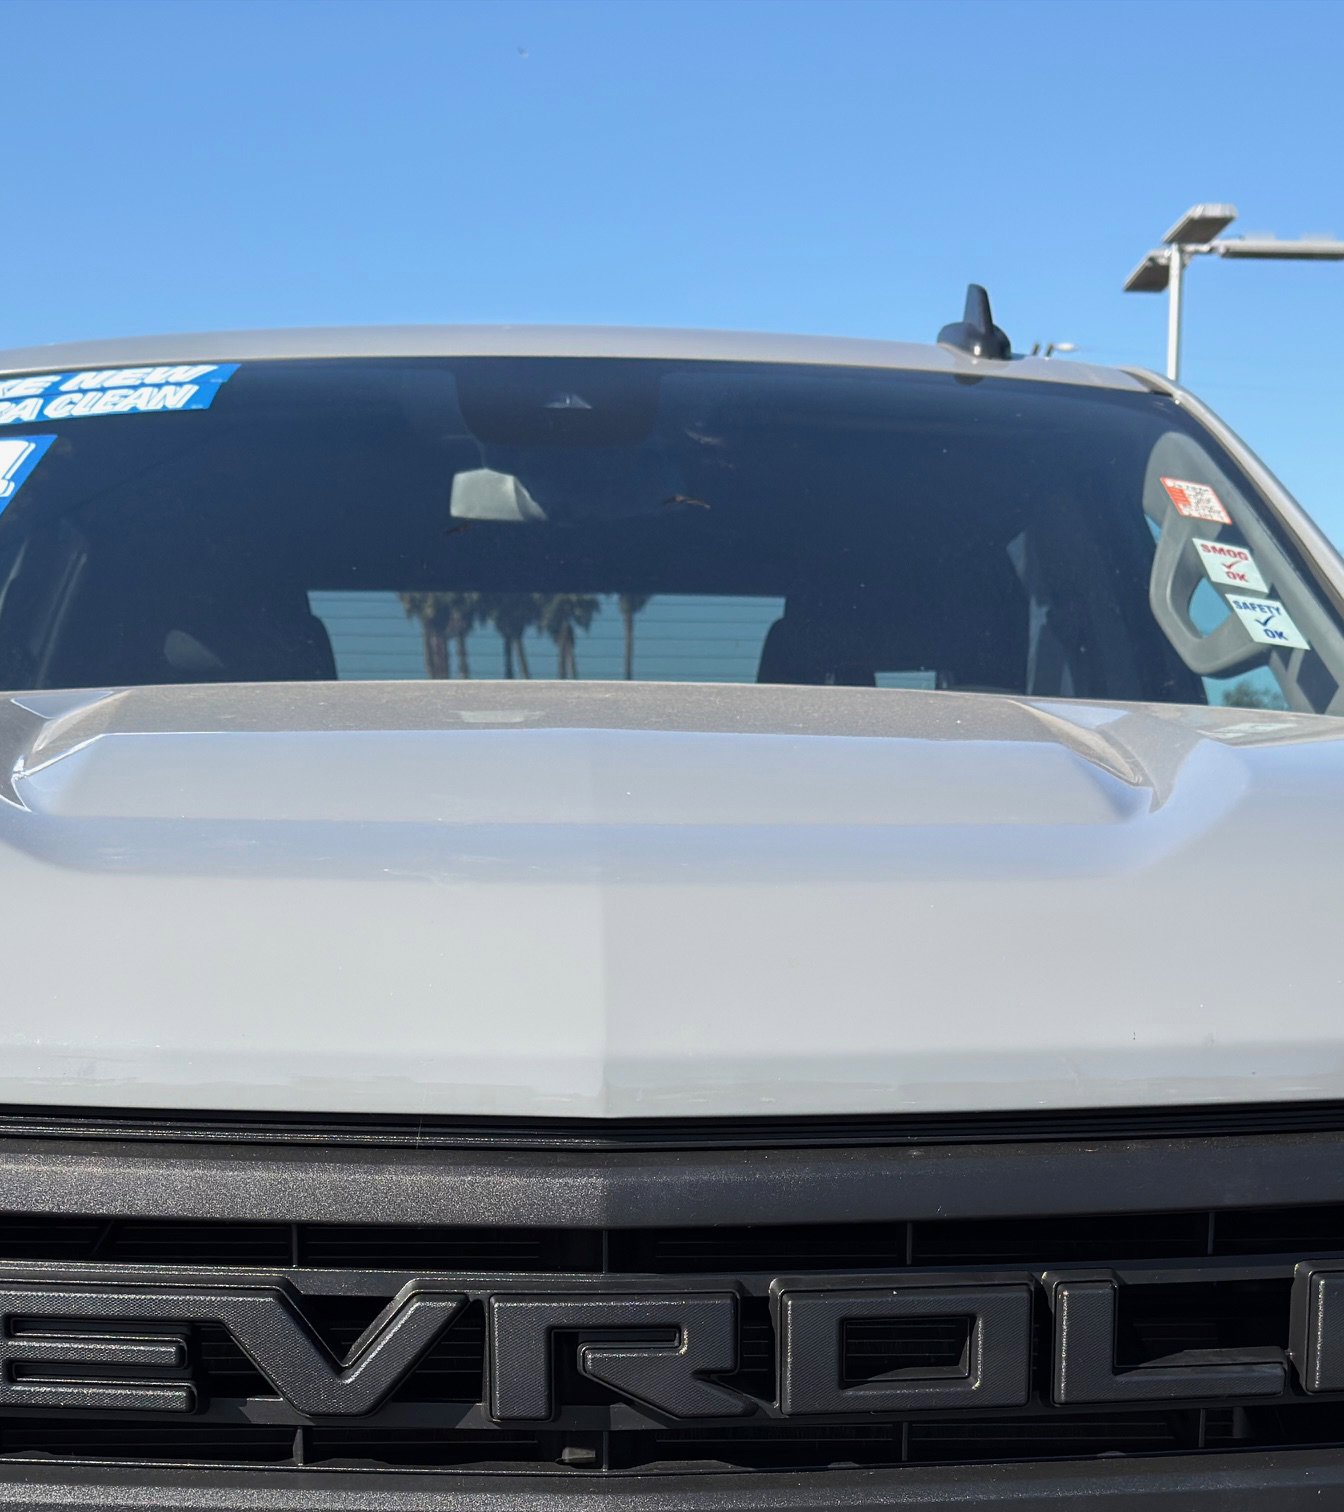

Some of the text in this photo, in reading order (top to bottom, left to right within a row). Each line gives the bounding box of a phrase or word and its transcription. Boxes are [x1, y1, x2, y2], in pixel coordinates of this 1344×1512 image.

[59, 364, 219, 392] NEW
[43, 384, 201, 418] CLEAN
[1200, 543, 1249, 561] SMOG
[1225, 571, 1248, 583] OK
[1232, 600, 1282, 616] SAFETY
[1263, 628, 1289, 641] OK
